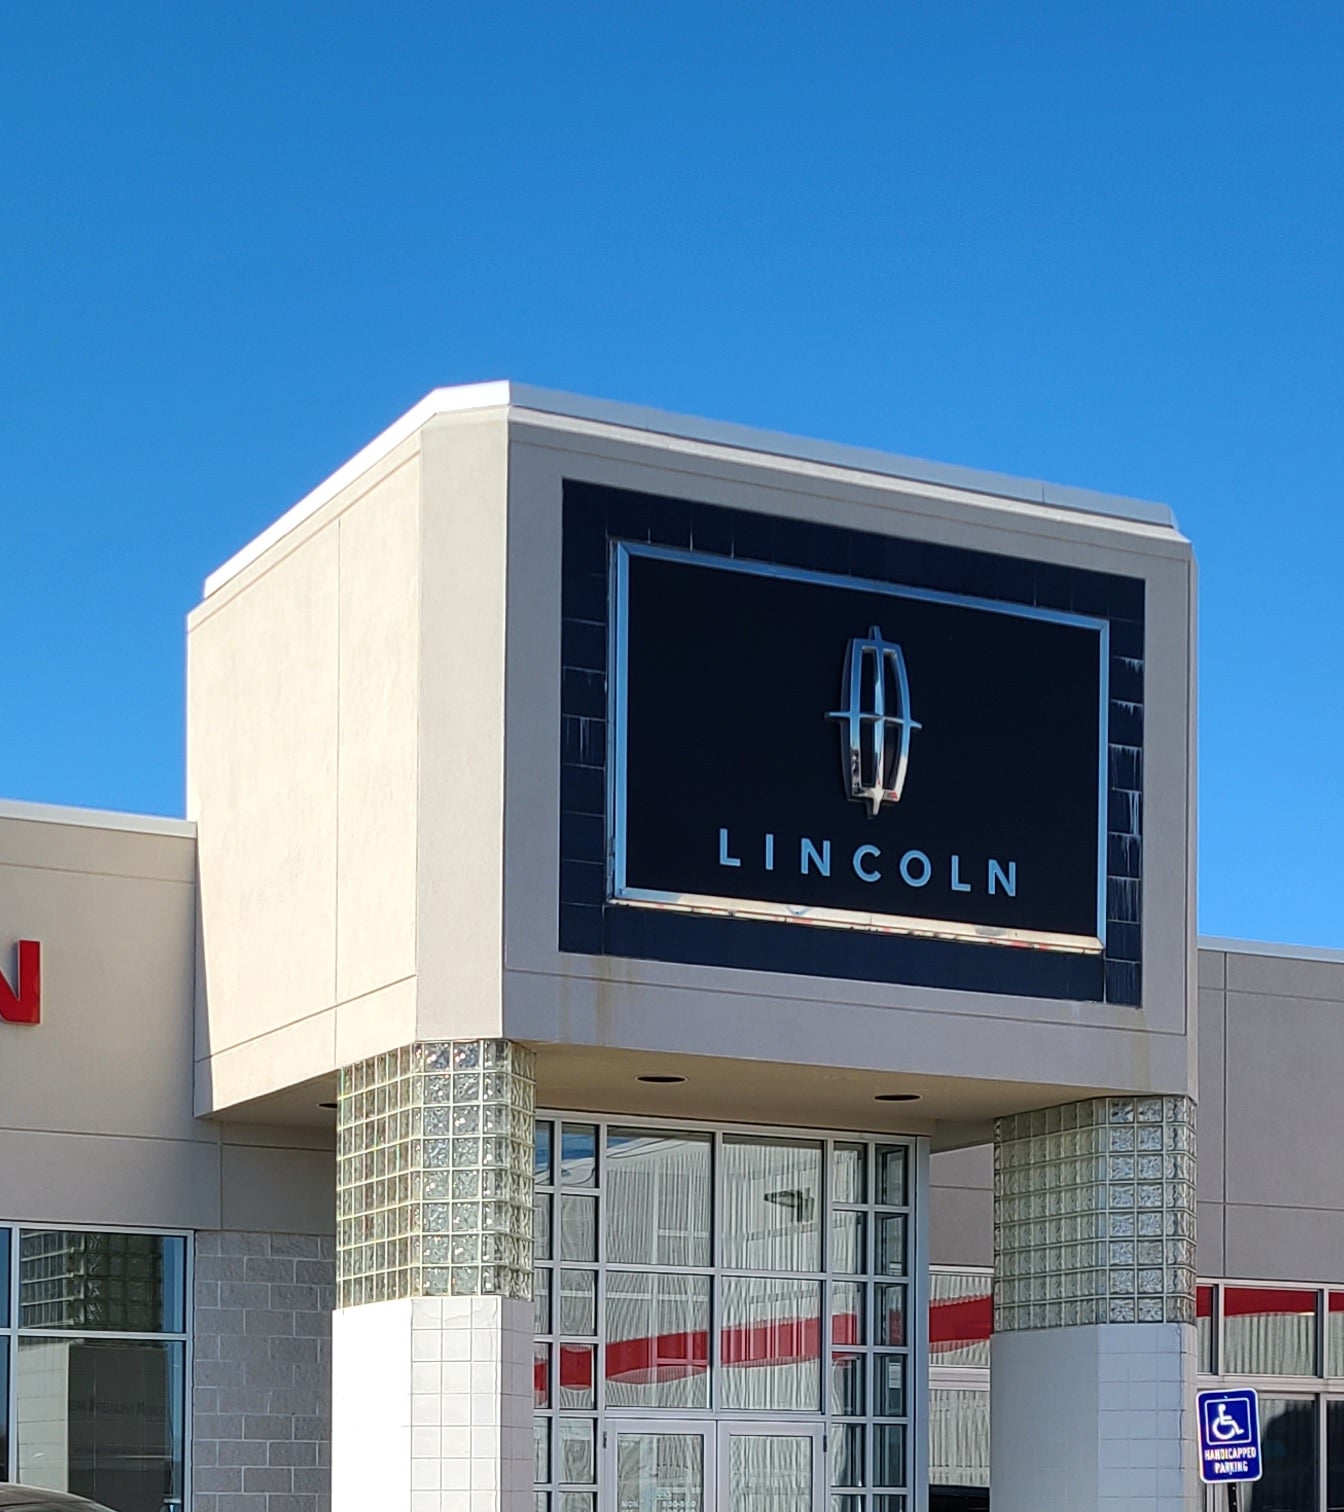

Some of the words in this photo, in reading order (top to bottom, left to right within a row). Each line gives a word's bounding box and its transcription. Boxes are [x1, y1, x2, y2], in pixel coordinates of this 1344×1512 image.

[718, 828, 1017, 897] LINCOLN
[1204, 1446, 1257, 1461] HANDICAPPED
[1214, 1460, 1249, 1474] PARKING
